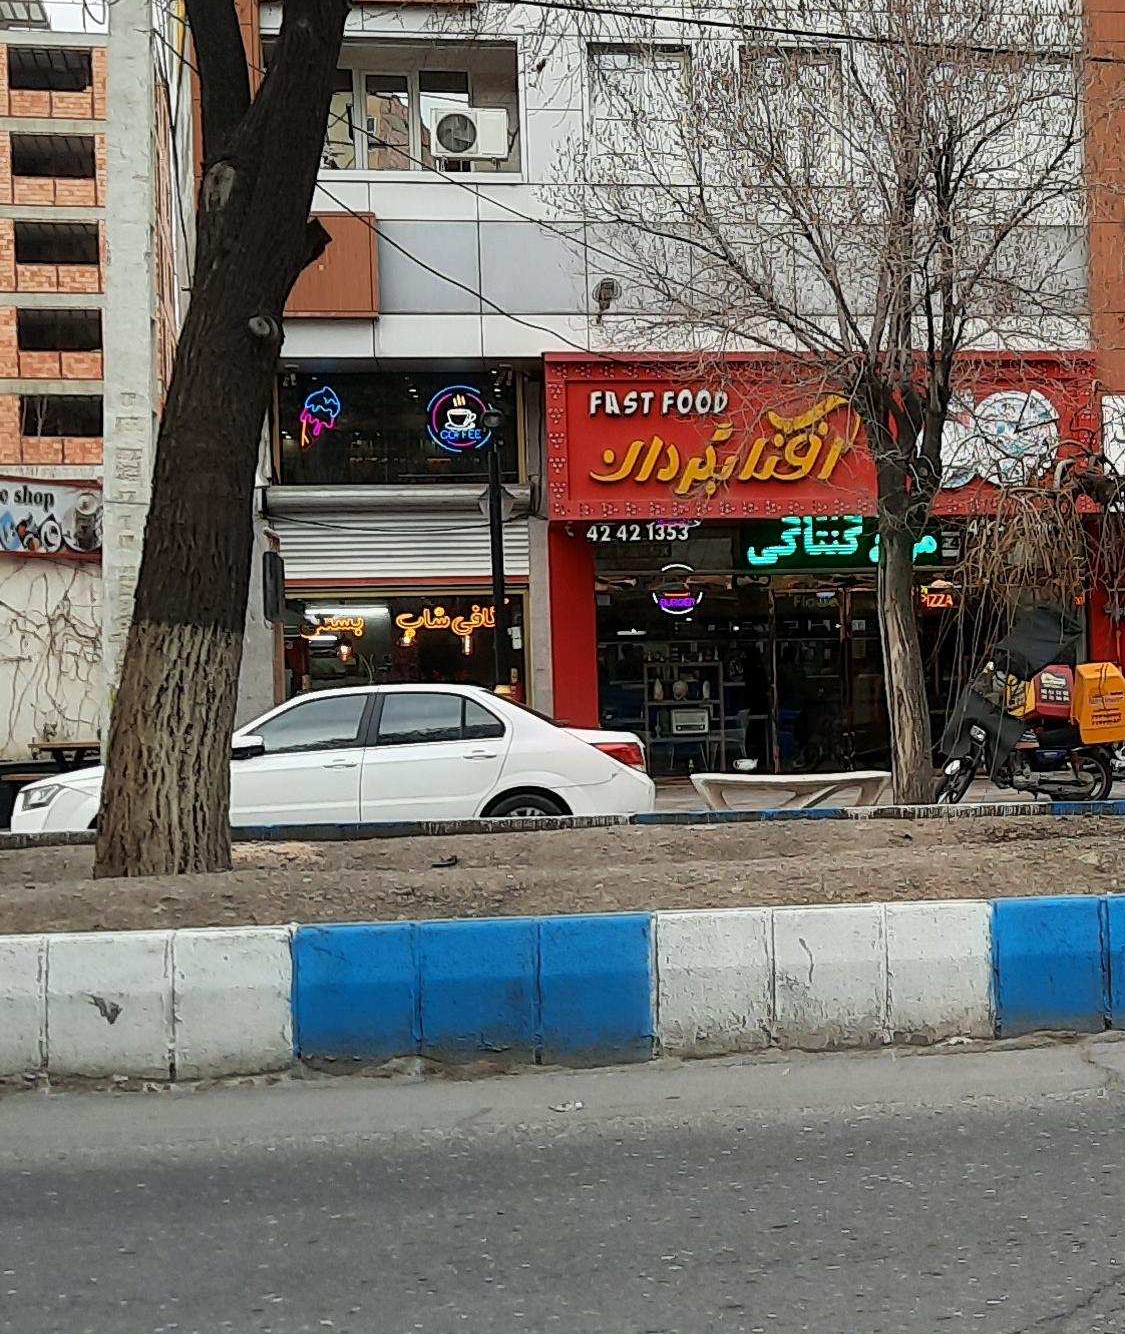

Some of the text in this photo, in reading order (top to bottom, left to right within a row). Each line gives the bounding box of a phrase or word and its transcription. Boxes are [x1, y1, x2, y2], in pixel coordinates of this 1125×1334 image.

[588, 388, 730, 416] FAST FOOD
[440, 429, 483, 440] COFFEE
[13, 485, 55, 513] shop
[586, 523, 689, 542] 42 42 1353
[396, 606, 450, 640] شاپ
